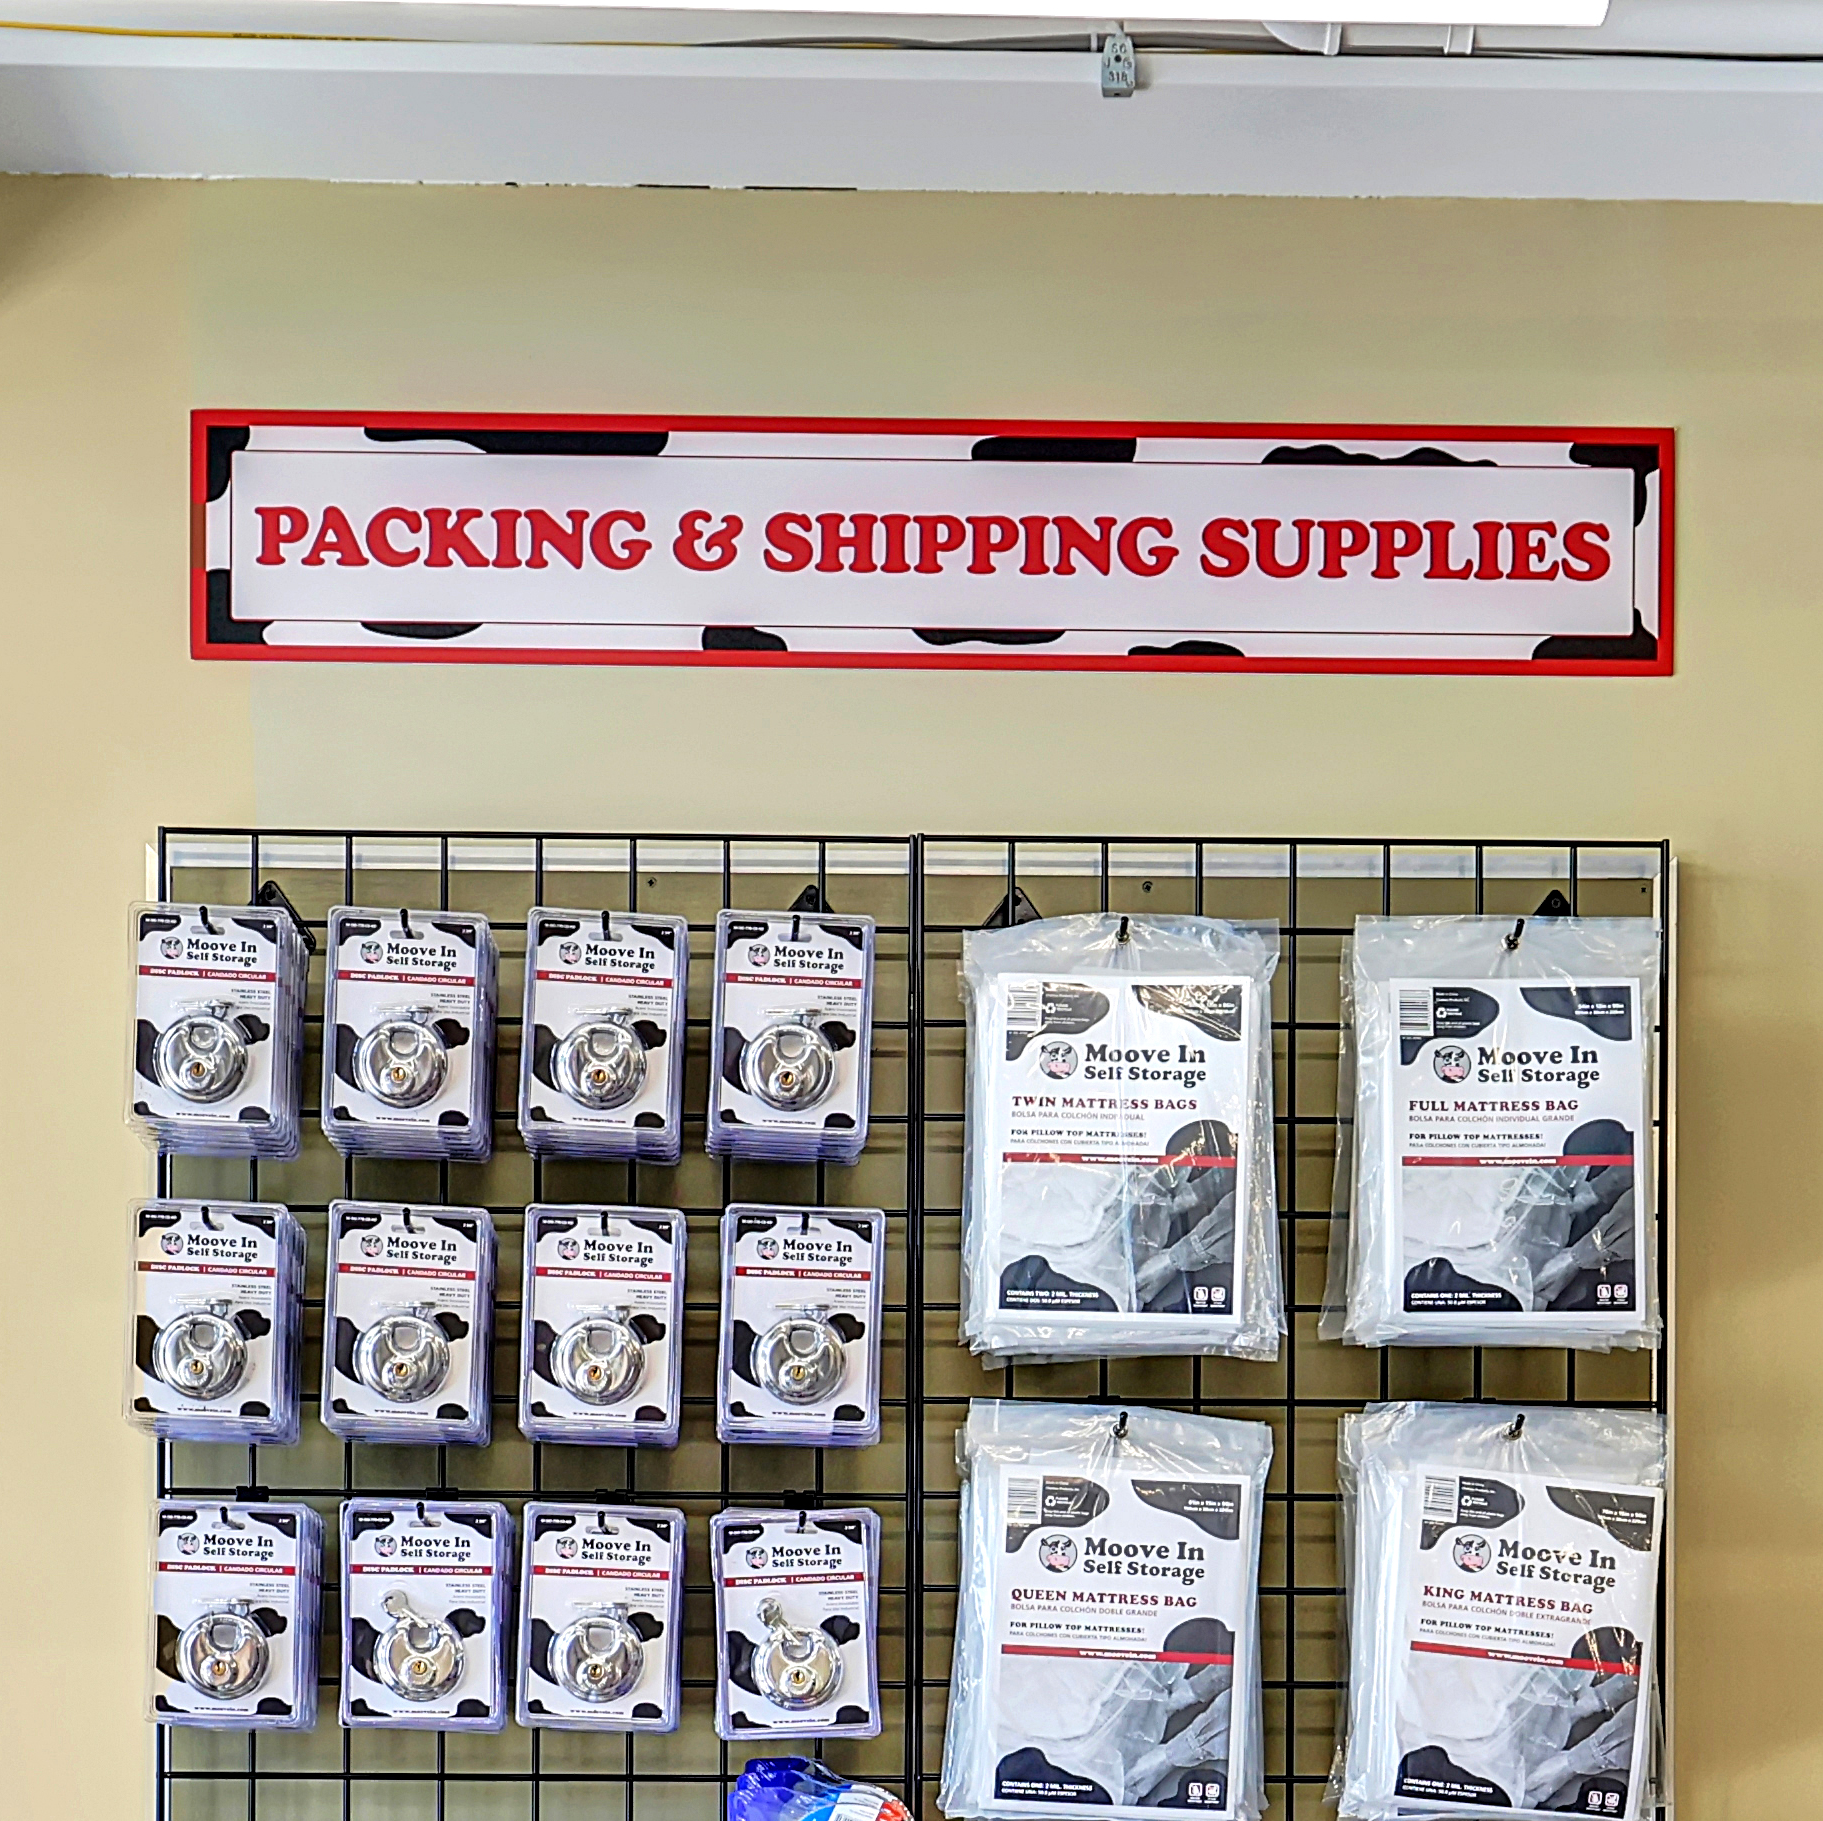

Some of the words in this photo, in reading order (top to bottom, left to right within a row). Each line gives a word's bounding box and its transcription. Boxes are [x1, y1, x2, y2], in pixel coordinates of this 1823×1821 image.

[255, 506, 652, 570] PACKING
[673, 510, 743, 571] &
[764, 512, 1179, 577] SHIPPING
[1200, 518, 1610, 581] SUPPLIES
[187, 939, 236, 951] Moove
[241, 941, 256, 953] In
[187, 952, 209, 960] Self
[212, 953, 257, 967] Storage
[1410, 1101, 1448, 1111] FULL
[1454, 1101, 1539, 1111] MATTRESS
[1546, 1100, 1578, 1110] BAG
[401, 1536, 450, 1547] Moove
[455, 1537, 470, 1547] In
[1084, 1537, 1169, 1559] Moove
[1177, 1542, 1204, 1560] In
[401, 1549, 422, 1557] Self
[426, 1549, 470, 1562] Storage
[1084, 1560, 1122, 1574] Self
[1127, 1562, 1204, 1585] Storage
[1012, 1589, 1066, 1601] QUEEN
[1073, 1592, 1158, 1605] MATTRESS
[1164, 1596, 1196, 1607] BAG
[1424, 1586, 1464, 1599] KING
[1470, 1591, 1555, 1609] MATTRESS
[1561, 1601, 1592, 1614] BAG
